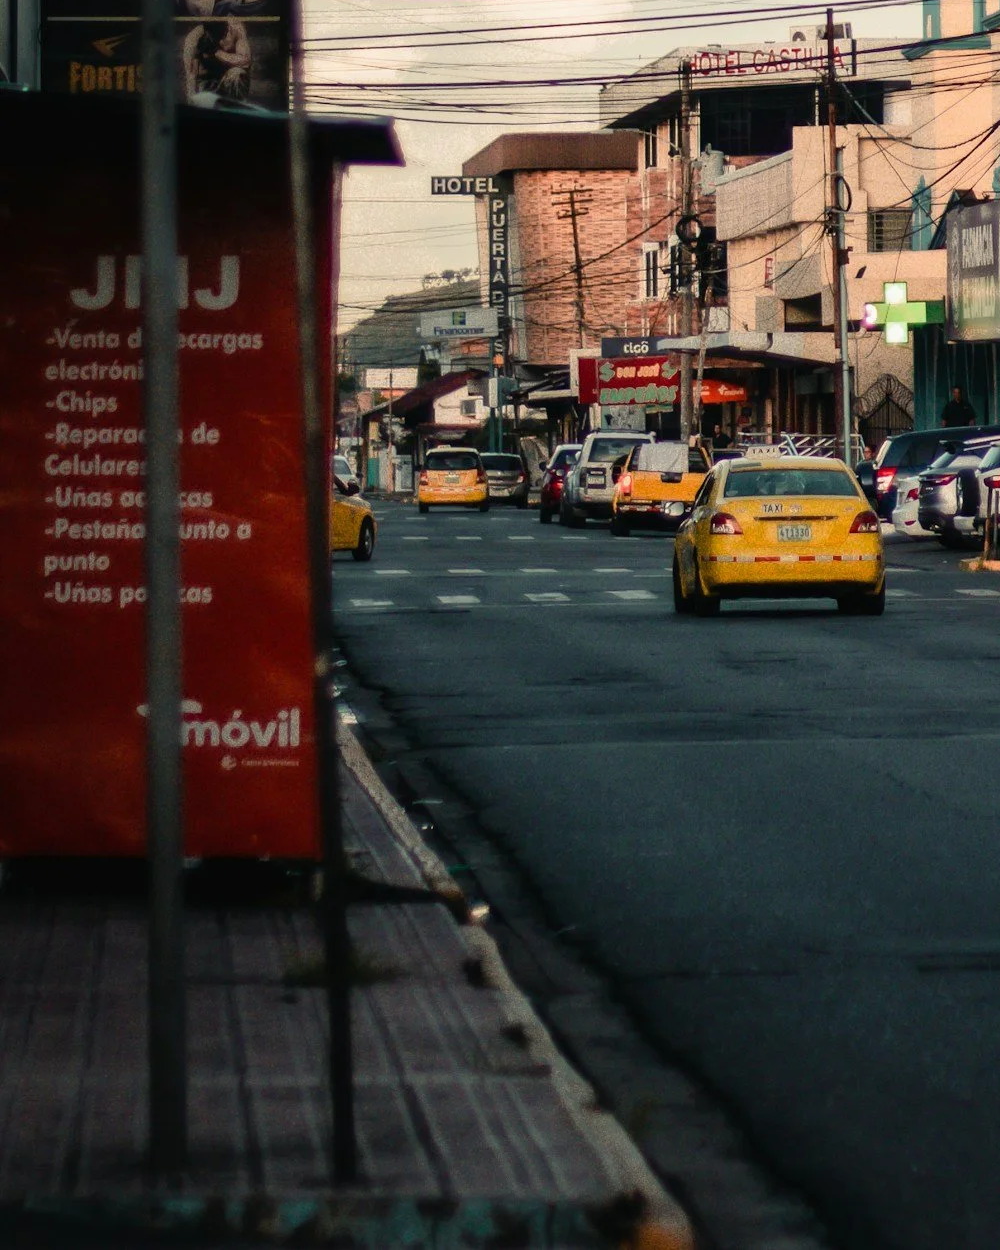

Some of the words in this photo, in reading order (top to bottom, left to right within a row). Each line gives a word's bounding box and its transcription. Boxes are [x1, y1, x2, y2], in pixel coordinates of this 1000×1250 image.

[433, 177, 500, 193] HOTEL
[492, 199, 505, 284] PUERTA
[191, 422, 221, 445] de
[763, 504, 784, 513] TAXI
[237, 523, 253, 540] a
[43, 552, 110, 577] punto
